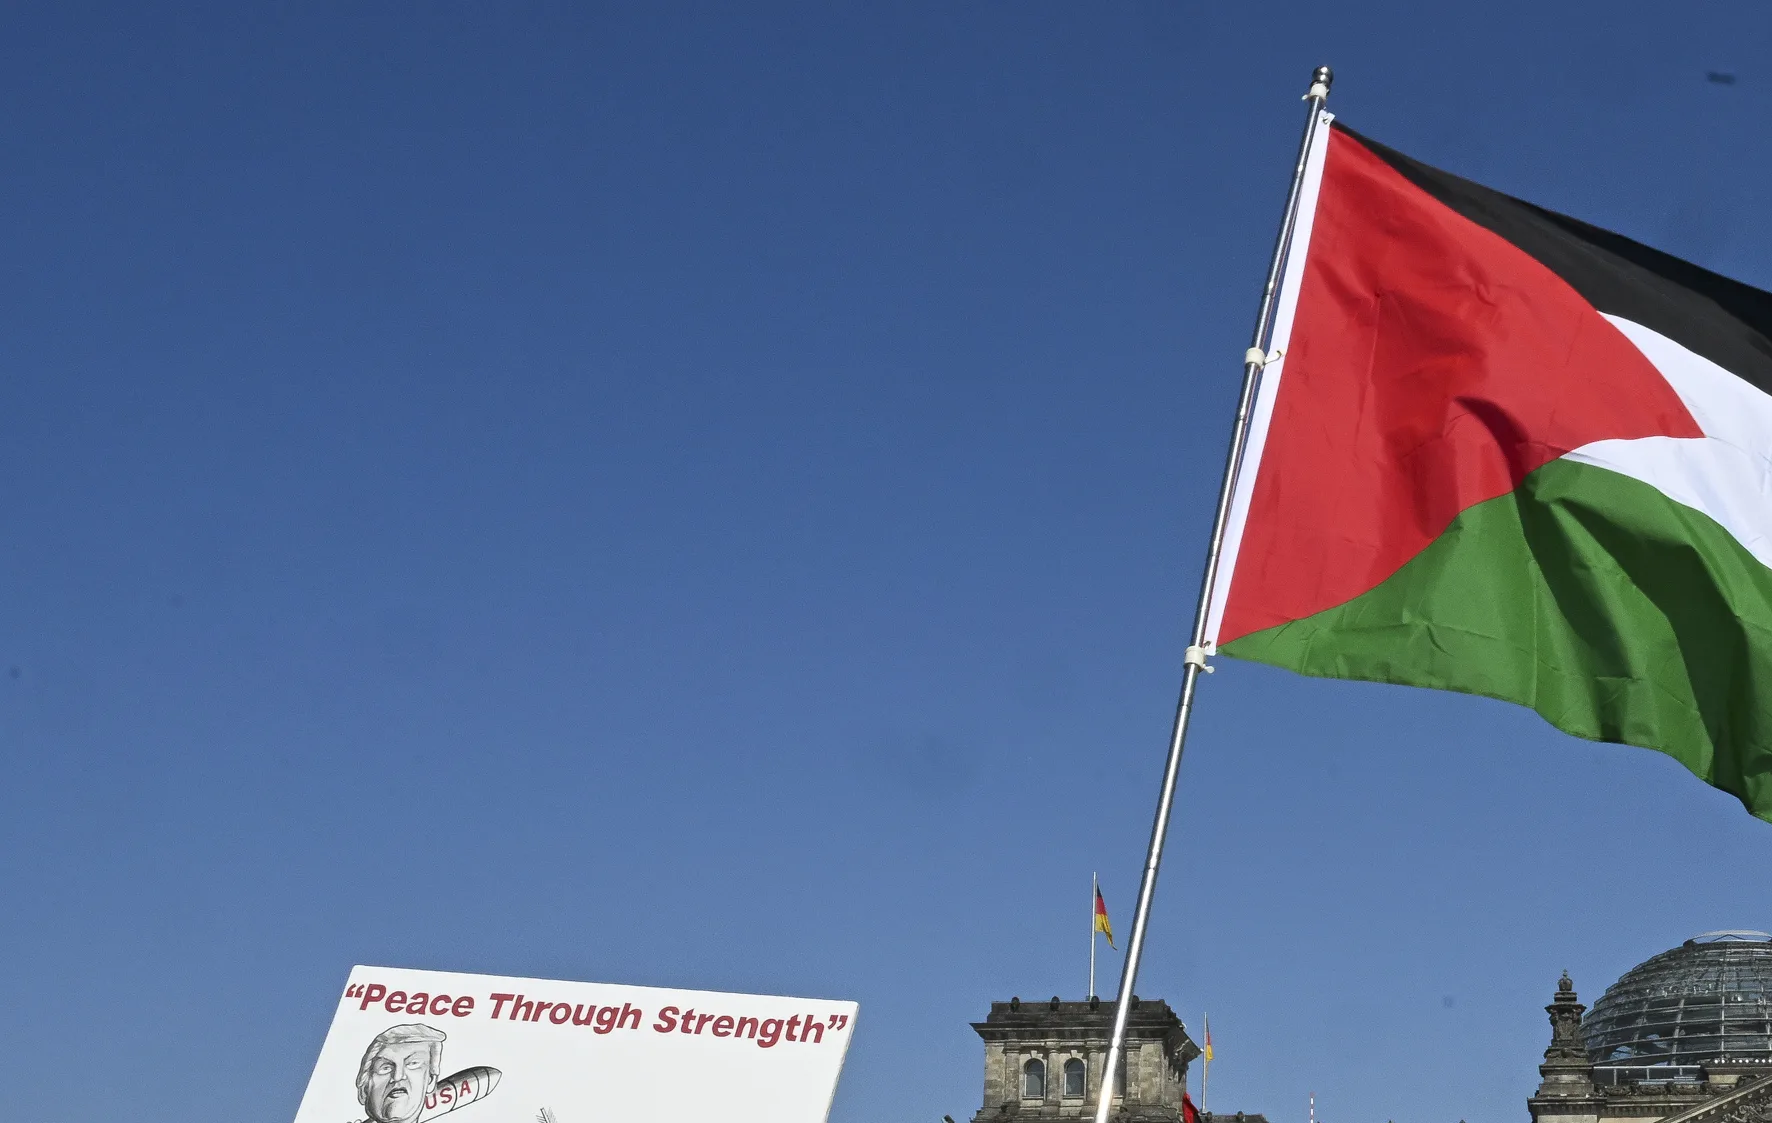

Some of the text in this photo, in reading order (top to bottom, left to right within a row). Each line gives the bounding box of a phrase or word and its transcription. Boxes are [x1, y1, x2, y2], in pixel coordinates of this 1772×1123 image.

[345, 983, 848, 1049] “Peace Through Strength”
[424, 1079, 472, 1110] USA
